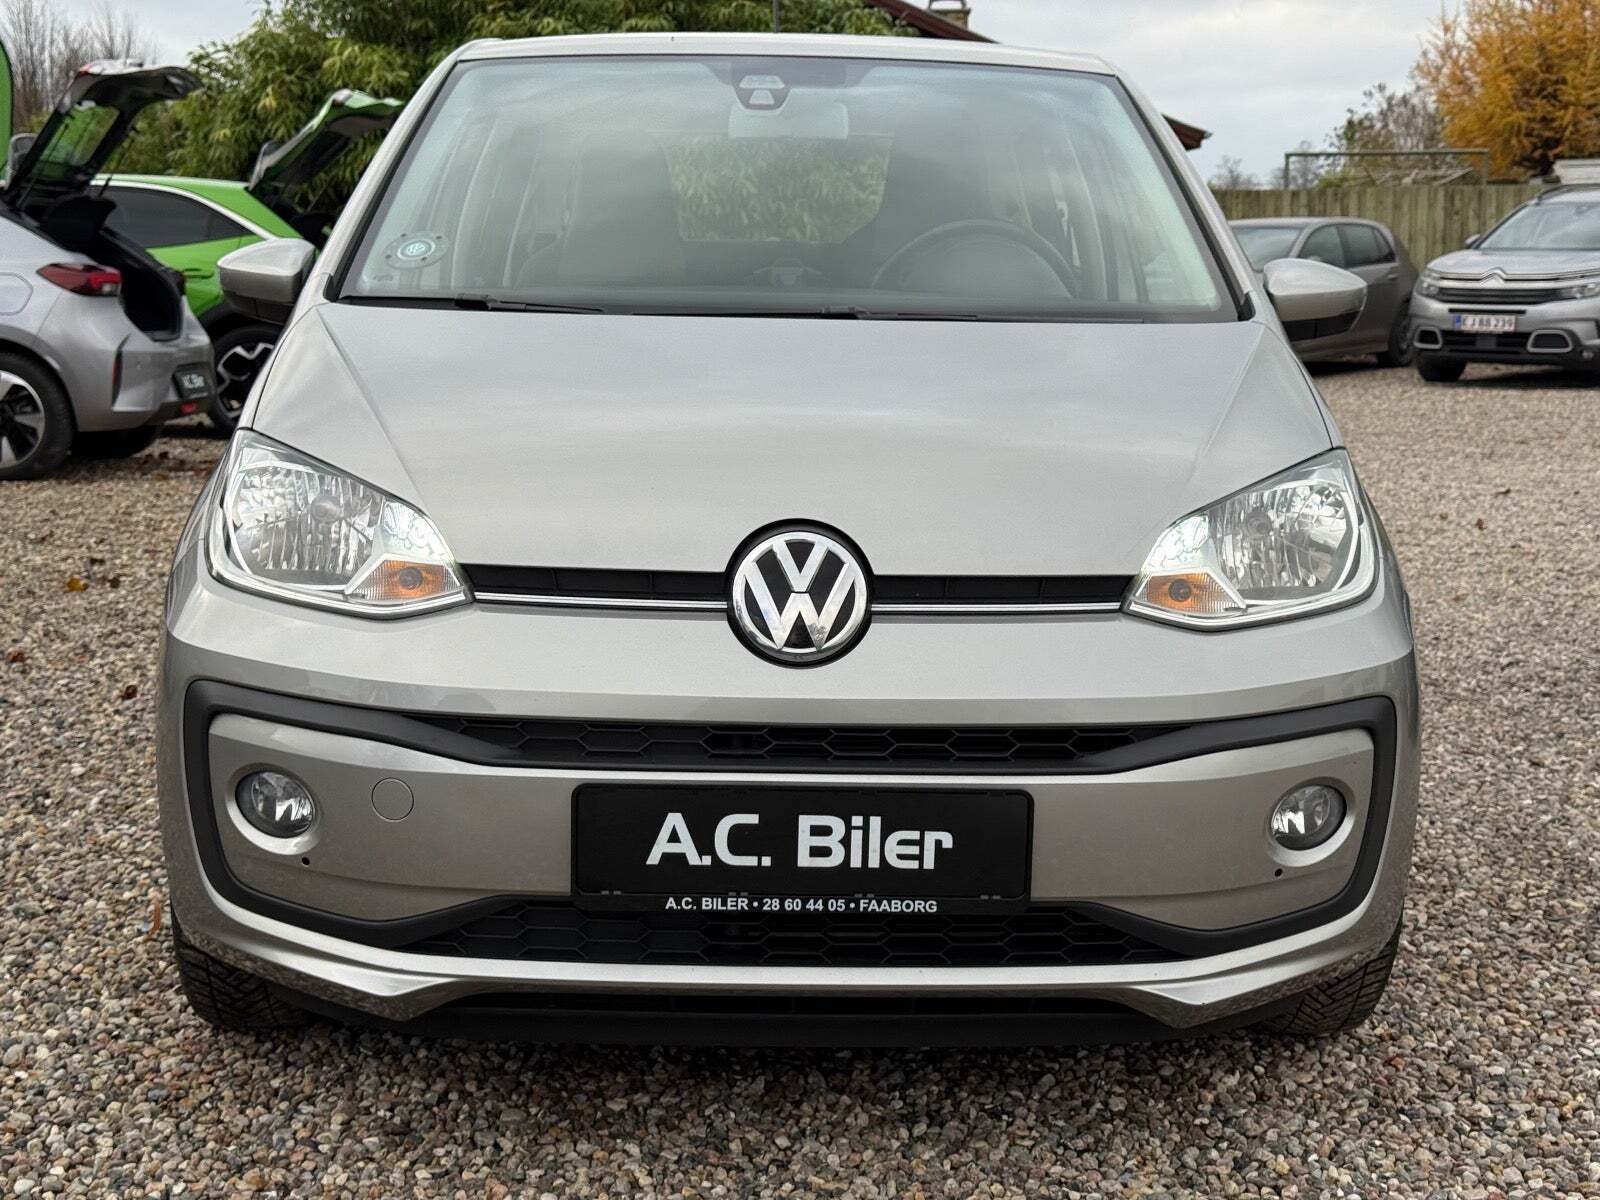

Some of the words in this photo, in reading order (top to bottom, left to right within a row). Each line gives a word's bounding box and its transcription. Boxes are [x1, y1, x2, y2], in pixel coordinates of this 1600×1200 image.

[738, 535, 861, 651] VW
[645, 812, 772, 867] A.C.
[797, 814, 954, 870] Biler
[665, 897, 697, 910] A.C.
[701, 897, 749, 911] BILER
[762, 898, 780, 911] 28
[784, 898, 802, 911] 60
[805, 898, 824, 912] 44
[827, 898, 846, 912] 05
[859, 899, 938, 913] FAABORG
